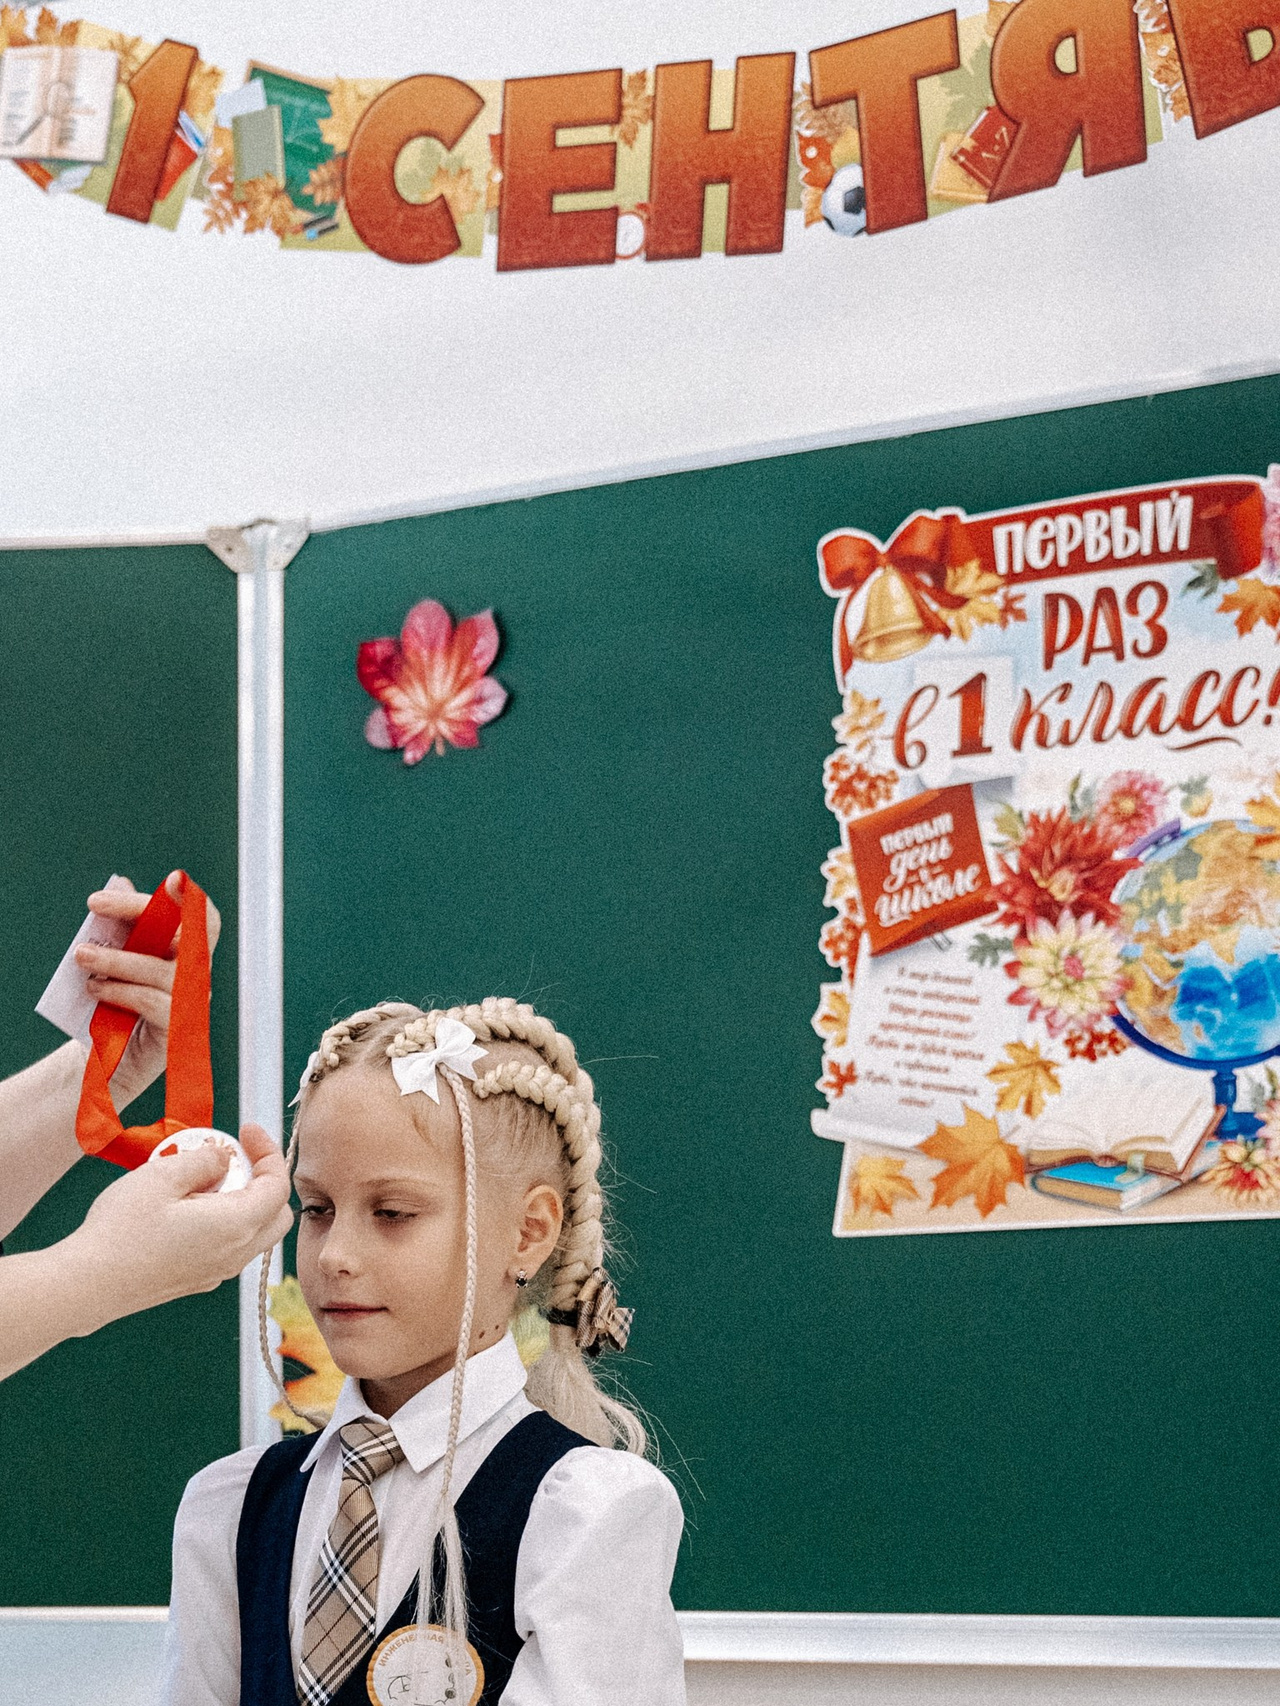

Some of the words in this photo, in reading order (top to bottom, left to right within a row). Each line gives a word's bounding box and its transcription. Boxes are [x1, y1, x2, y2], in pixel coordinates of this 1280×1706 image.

[106, 38, 199, 224] 1
[992, 490, 1194, 575] ПЕРВЫЙ
[1042, 580, 1170, 671] РАЗ
[892, 684, 940, 769] в
[949, 672, 992, 758] 1
[1009, 666, 1280, 752] класс!
[883, 837, 953, 892] день
[378, 1633, 444, 1667] ИНЖЕНЕАЯ
